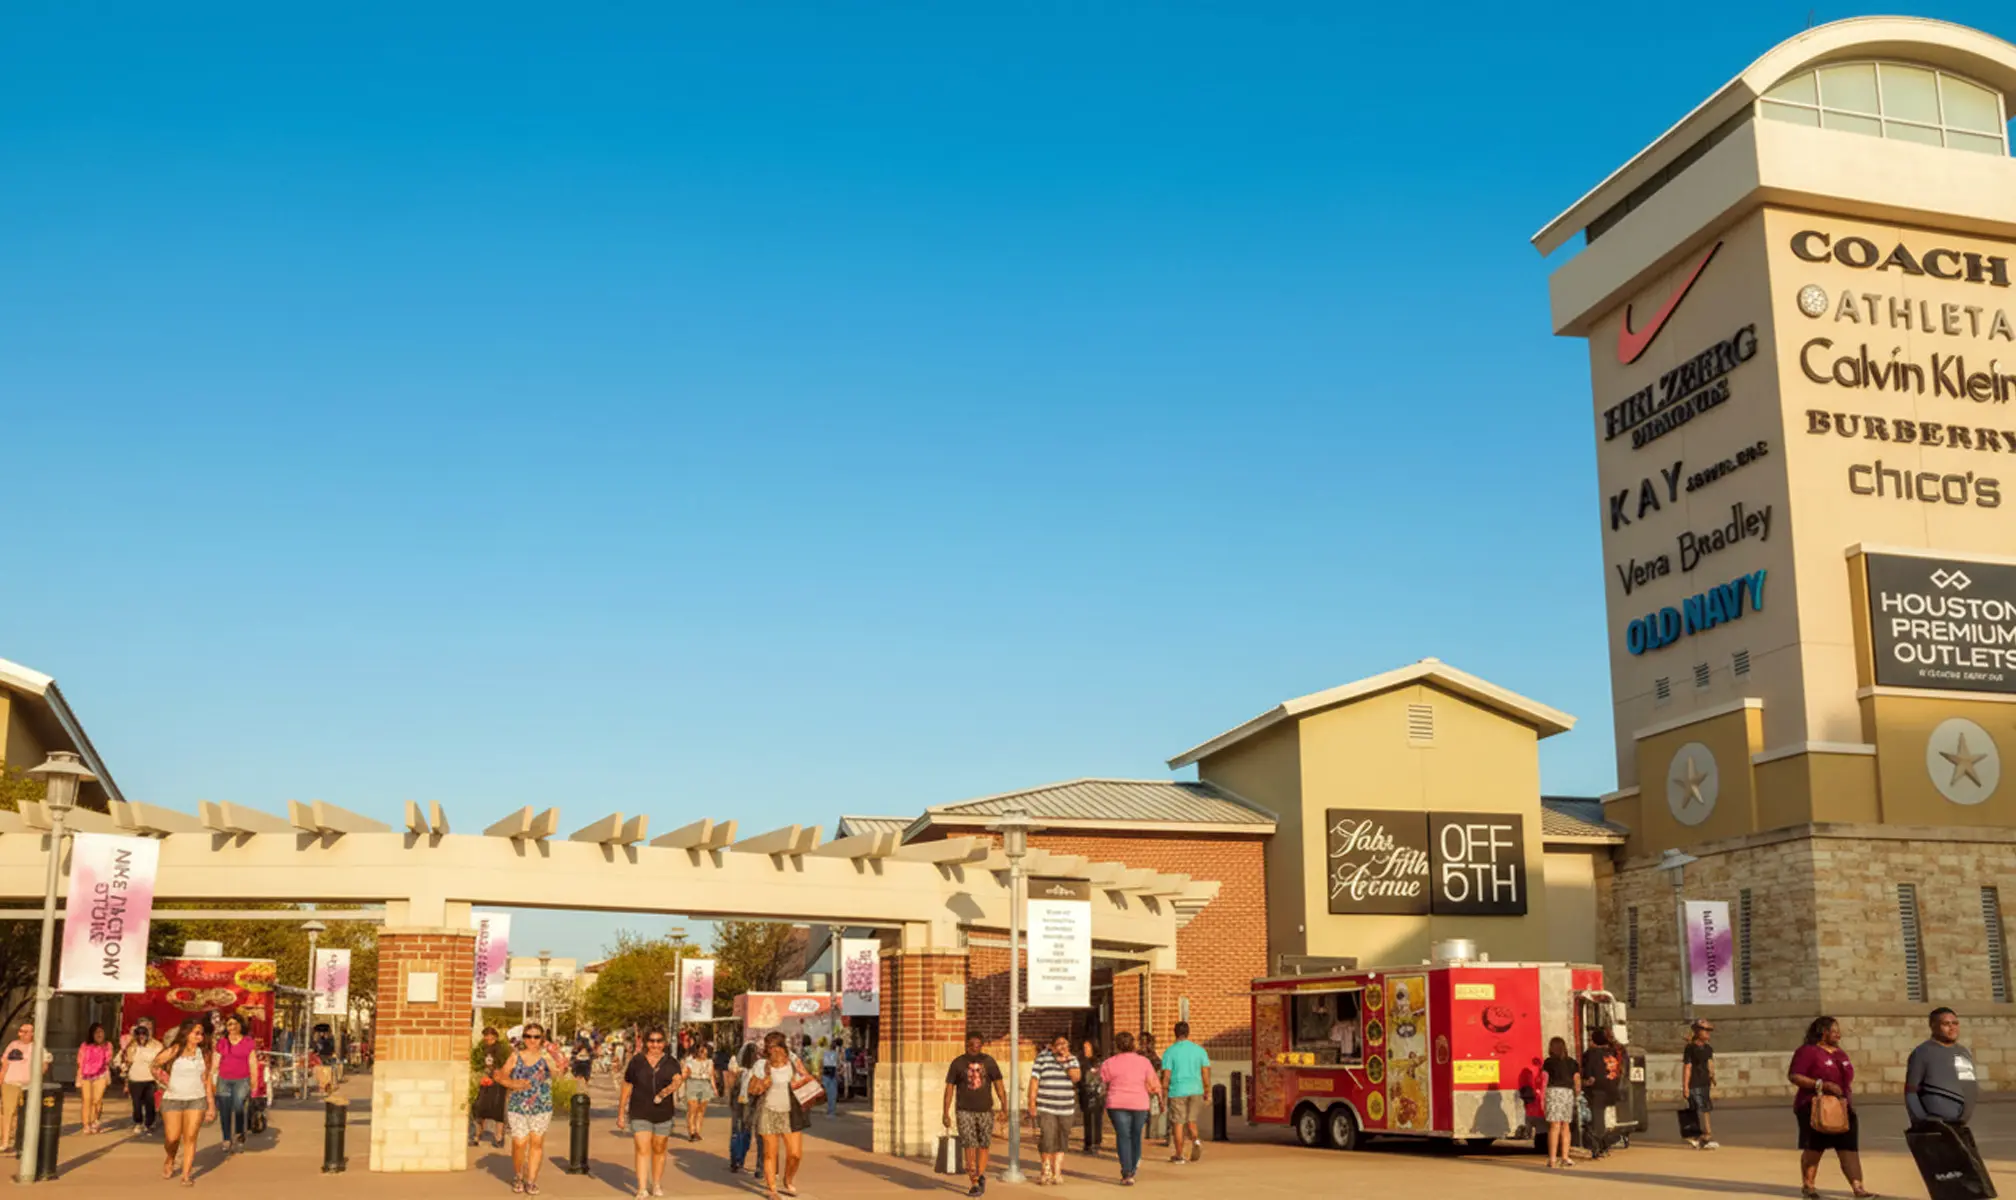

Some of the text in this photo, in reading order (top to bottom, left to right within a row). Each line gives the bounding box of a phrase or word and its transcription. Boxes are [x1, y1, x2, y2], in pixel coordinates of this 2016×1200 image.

[1790, 230, 2011, 288] COACH
[1834, 289, 2015, 342] ATHLETA
[1800, 337, 2016, 404] Calvin Klein
[1806, 408, 2016, 454] BURBERRY
[1610, 460, 1683, 532] KAY
[1848, 459, 2001, 508] chico's
[1616, 502, 1772, 597] Vera Bradley
[1626, 568, 1768, 656] OLD NAVY
[1881, 591, 2016, 621] HOUSTON
[1891, 618, 2016, 645] PREMIUM
[1894, 642, 2016, 670] OUTLETS
[1440, 823, 1514, 863] OFF
[1442, 863, 1517, 902] 5TH
